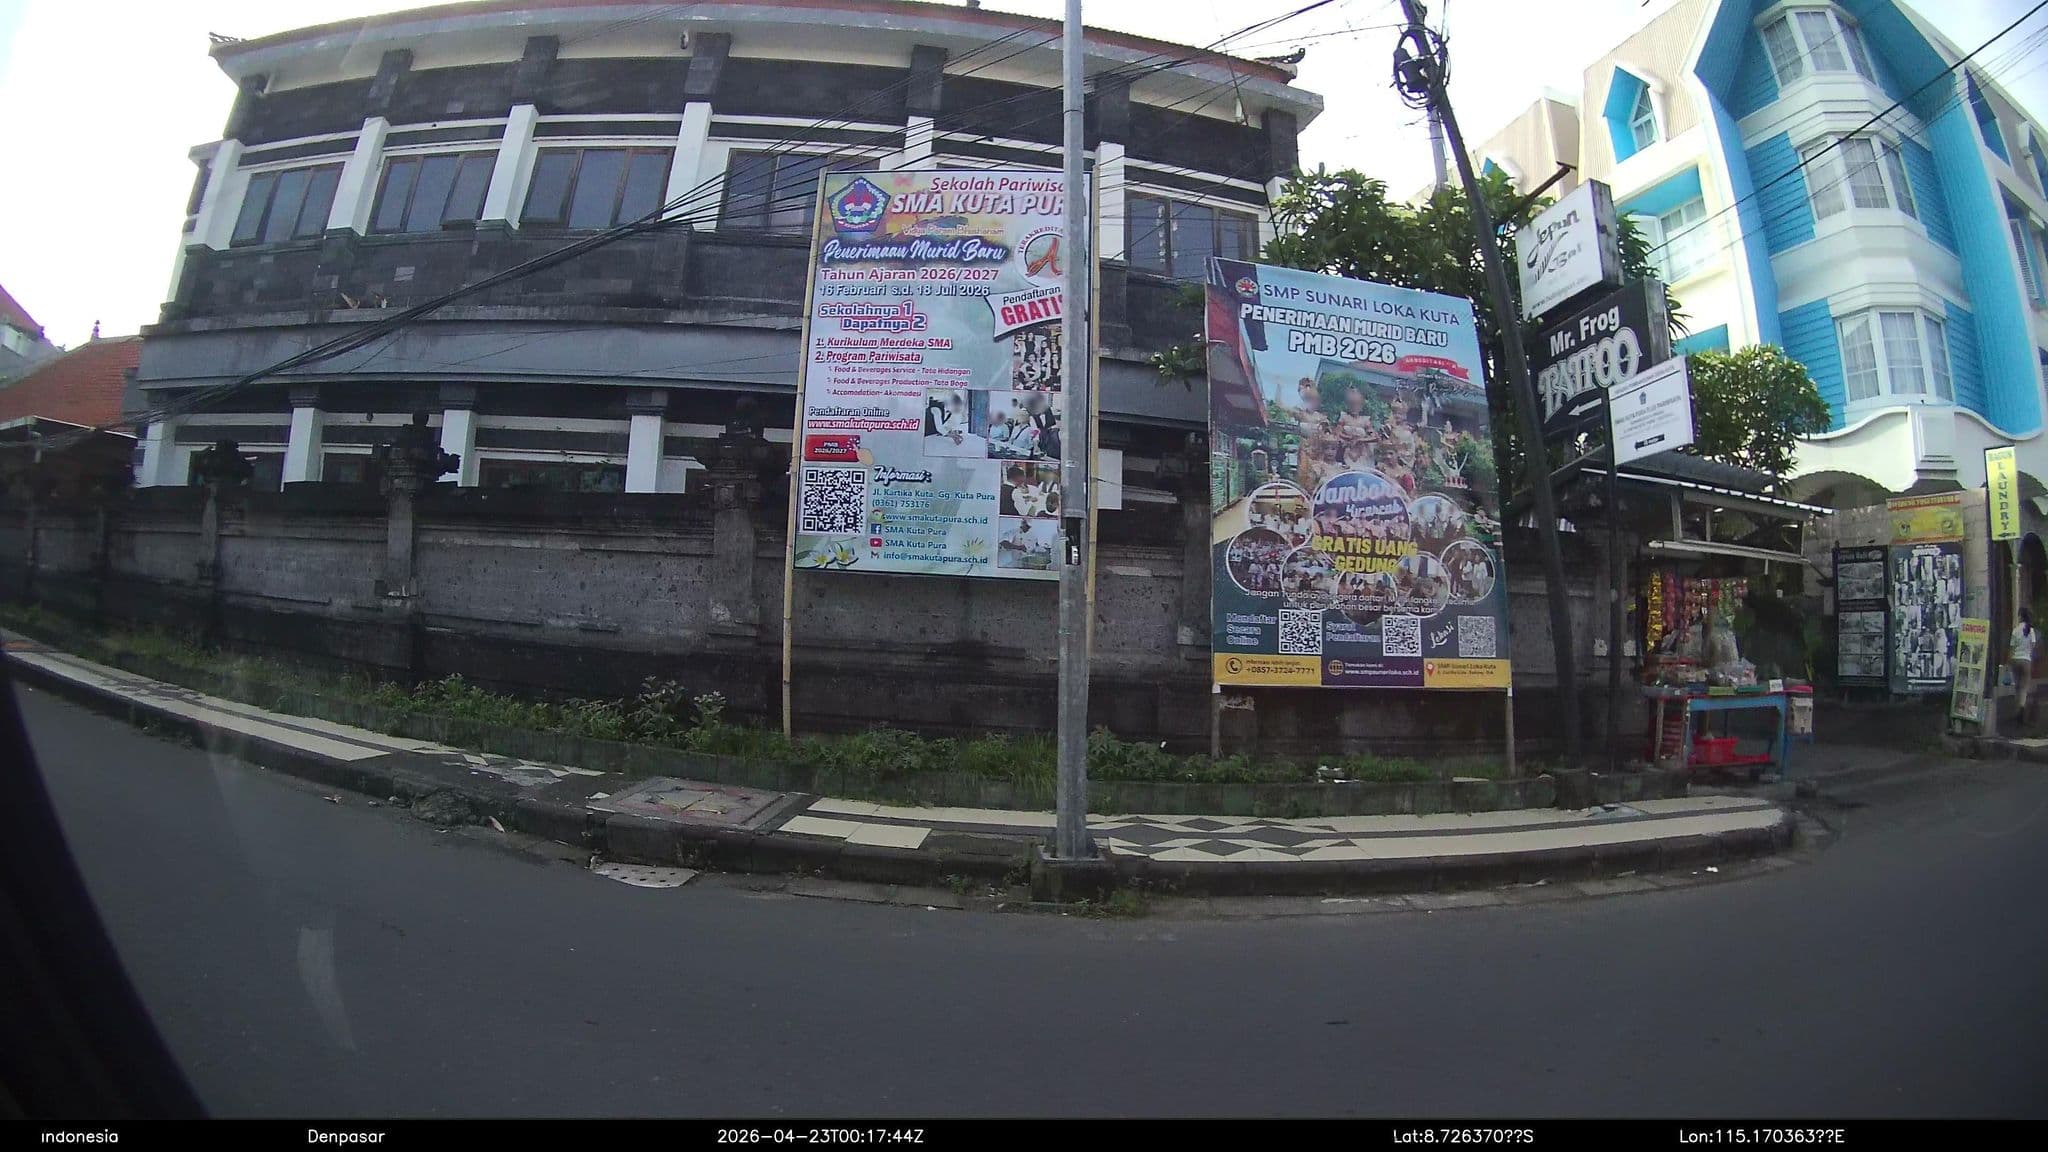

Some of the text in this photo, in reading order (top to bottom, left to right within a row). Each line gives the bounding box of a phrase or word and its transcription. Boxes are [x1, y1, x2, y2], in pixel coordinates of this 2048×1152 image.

[931, 177, 1064, 192] Sekolah Pariwis
[891, 193, 944, 215] SMA
[950, 193, 1015, 215] KUTA
[823, 239, 1006, 262] Penerimaan Murid Baru
[822, 269, 999, 282] Tahun Ajaran 2026/2027
[836, 285, 887, 296] Februari
[917, 285, 932, 296] 18
[935, 285, 957, 296] Juli
[959, 285, 990, 297] 2026
[1003, 286, 1061, 305] Pendaftaran
[819, 300, 914, 318] Sekolahnya 1
[1000, 295, 1063, 326] GRATI
[1264, 284, 1460, 325] SMP SUNARI LOKA KUTA
[841, 313, 927, 331] Dapatnya 2
[1240, 302, 1448, 347] PENERIMAAN MURID BARU
[1550, 305, 1620, 357] Mr. Frog
[827, 337, 878, 347] Kurikulum
[880, 338, 924, 347] Merdeka
[927, 338, 952, 348] SMA
[1289, 329, 1396, 365] PMB 2026
[826, 351, 867, 363] Program
[869, 351, 921, 362] Pariwisata
[858, 367, 891, 375] Beverages
[937, 368, 970, 376] Hidangan
[1537, 326, 1643, 424] TATTOO
[808, 407, 890, 417] Pendaftaran Online
[807, 419, 920, 431] www.smakutapura.sch.id
[955, 491, 974, 499] Kuta
[976, 492, 996, 500] Pura
[1998, 461, 2009, 531] LAUNDRY
[872, 500, 898, 508] (0361)
[885, 513, 988, 525] www.smakutapura.sch.id
[885, 526, 947, 536] SMA Kuta Pura
[885, 540, 947, 550] SMA Kuta Pura
[1311, 535, 1371, 555] GRATIS
[883, 552, 988, 564] info@smakutapura.sch.id
[1245, 590, 1279, 599] Jangan
